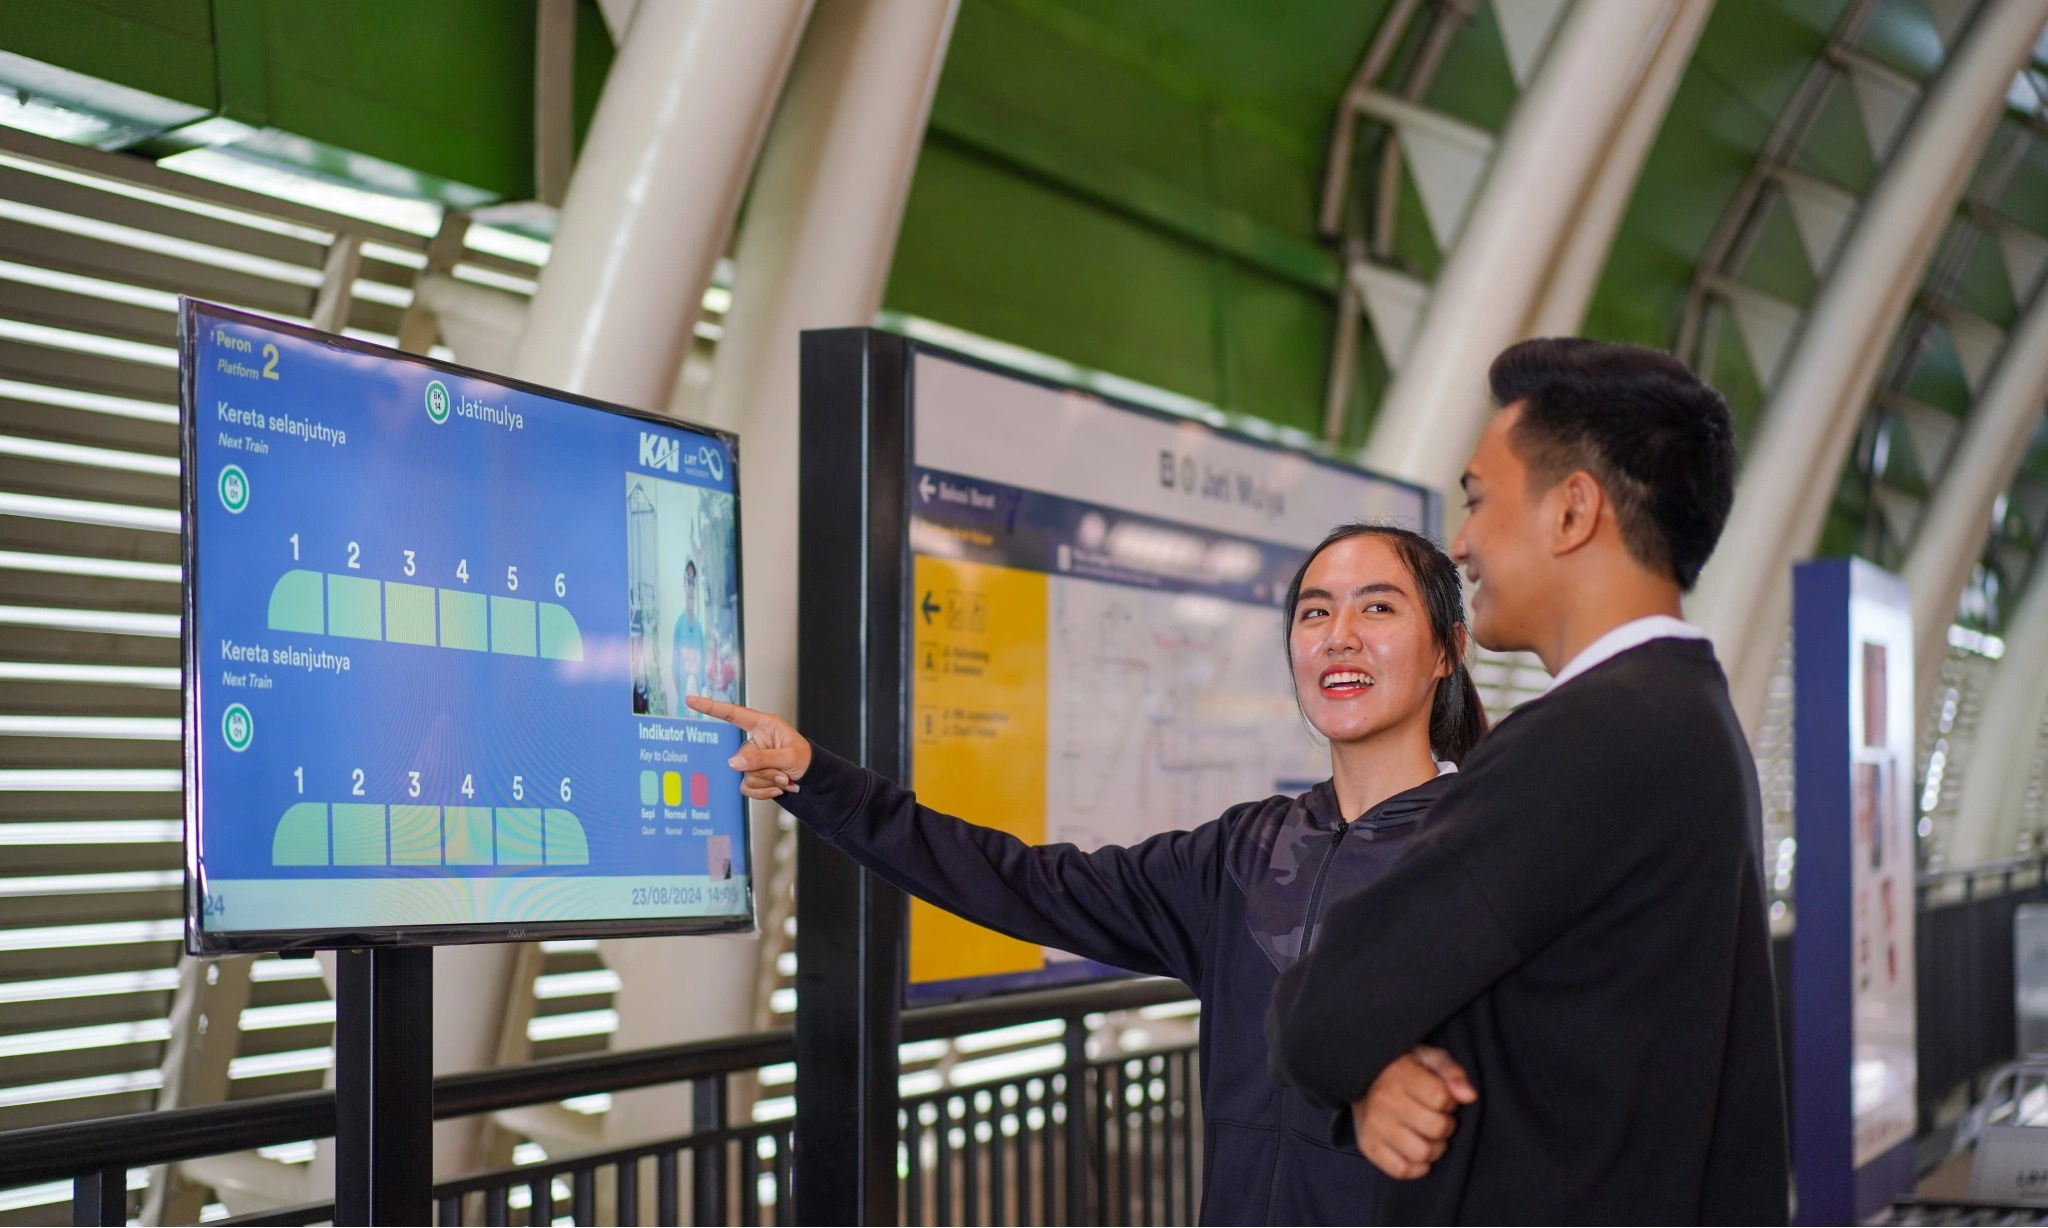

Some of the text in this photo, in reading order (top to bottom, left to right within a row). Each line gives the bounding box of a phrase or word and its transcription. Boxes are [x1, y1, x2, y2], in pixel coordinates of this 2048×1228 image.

[217, 330, 251, 353] Peron
[217, 358, 259, 380] Platform
[262, 343, 279, 380] 2
[433, 391, 442, 400] BK
[435, 402, 441, 411] 14
[456, 395, 523, 431] Jatimulya
[218, 400, 346, 447] Kereta selanjutnya
[218, 432, 269, 454] Next Train
[639, 431, 679, 473] KAI
[229, 476, 239, 487] BK
[230, 489, 238, 499] 01
[290, 534, 566, 598] 1 2 3 4 5 6
[221, 639, 350, 674] Kereta selanjutnya
[222, 671, 272, 688] Next Train
[232, 714, 242, 724] BK
[234, 728, 242, 738] 01
[639, 723, 719, 744] Indikator Warna
[639, 748, 688, 763] Key to Colours
[294, 767, 571, 802] 1 2 3 4 5 6
[641, 808, 710, 820] Sepi Normal Ramai
[632, 886, 702, 905] 23/08/2024
